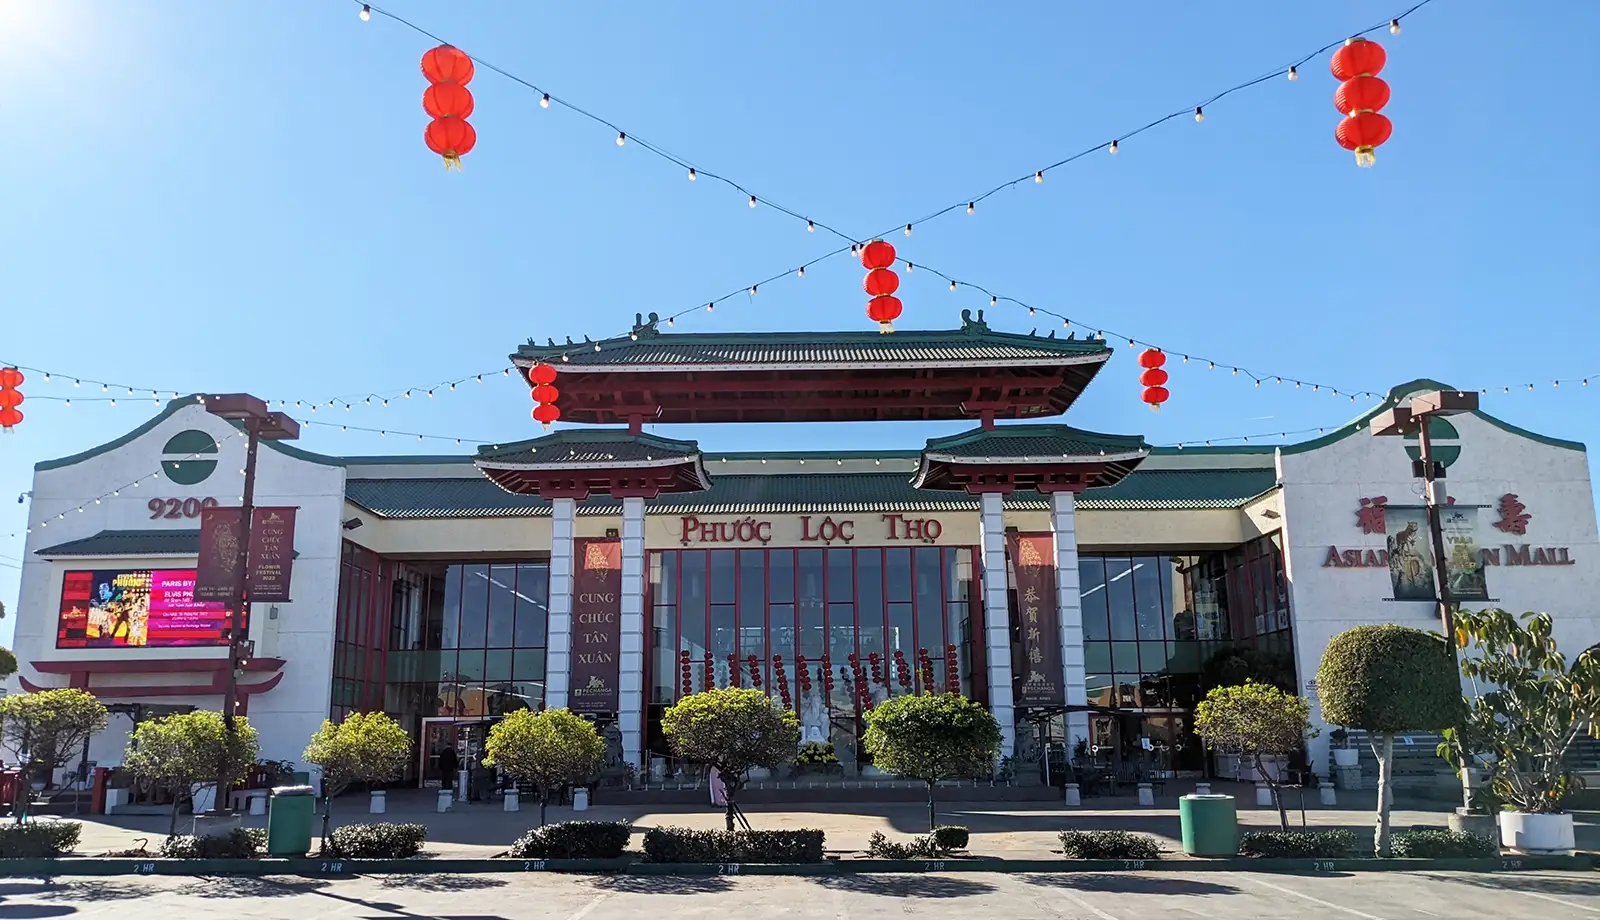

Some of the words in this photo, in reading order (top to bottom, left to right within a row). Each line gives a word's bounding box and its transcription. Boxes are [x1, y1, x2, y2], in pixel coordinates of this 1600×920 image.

[800, 515, 854, 545] LỘC
[882, 513, 943, 543] THỌ
[1504, 543, 1576, 566] MALL
[579, 593, 614, 603] CUNG
[579, 610, 614, 623] CHÚC
[1024, 585, 1043, 664] 恭賀新禧
[583, 631, 608, 643] TÂN
[578, 651, 612, 664] XUÂN
[134, 864, 139, 873] 2
[143, 863, 154, 872] HR
[321, 862, 327, 871] 2
[331, 863, 342, 871] HR
[525, 861, 530, 870] 2
[534, 861, 545, 870] HR
[718, 865, 723, 874] 2
[728, 864, 739, 873] HR
[925, 862, 929, 870] 2
[934, 861, 944, 870] HR
[1124, 860, 1129, 869] 2
[1134, 860, 1144, 869] HR
[1314, 862, 1319, 871] 2
[1323, 862, 1335, 870] HR
